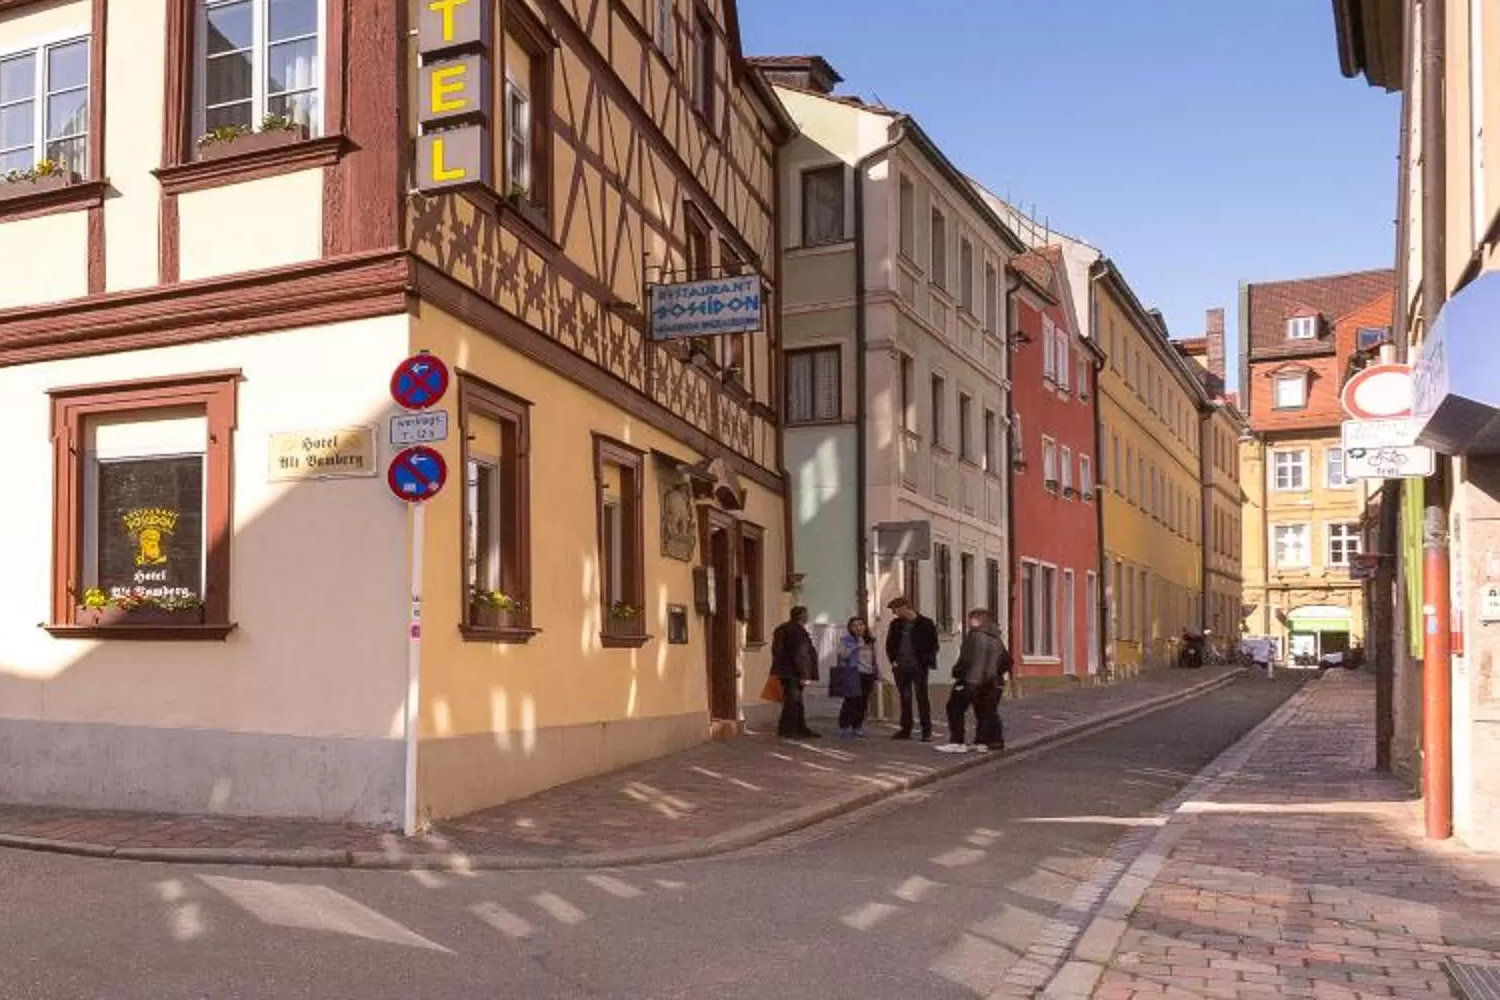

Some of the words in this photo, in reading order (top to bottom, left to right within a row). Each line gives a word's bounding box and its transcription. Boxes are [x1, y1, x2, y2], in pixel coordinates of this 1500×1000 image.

[302, 435, 337, 451] Hotel
[305, 453, 364, 468] Bamberg
[133, 569, 167, 584] Hotel
